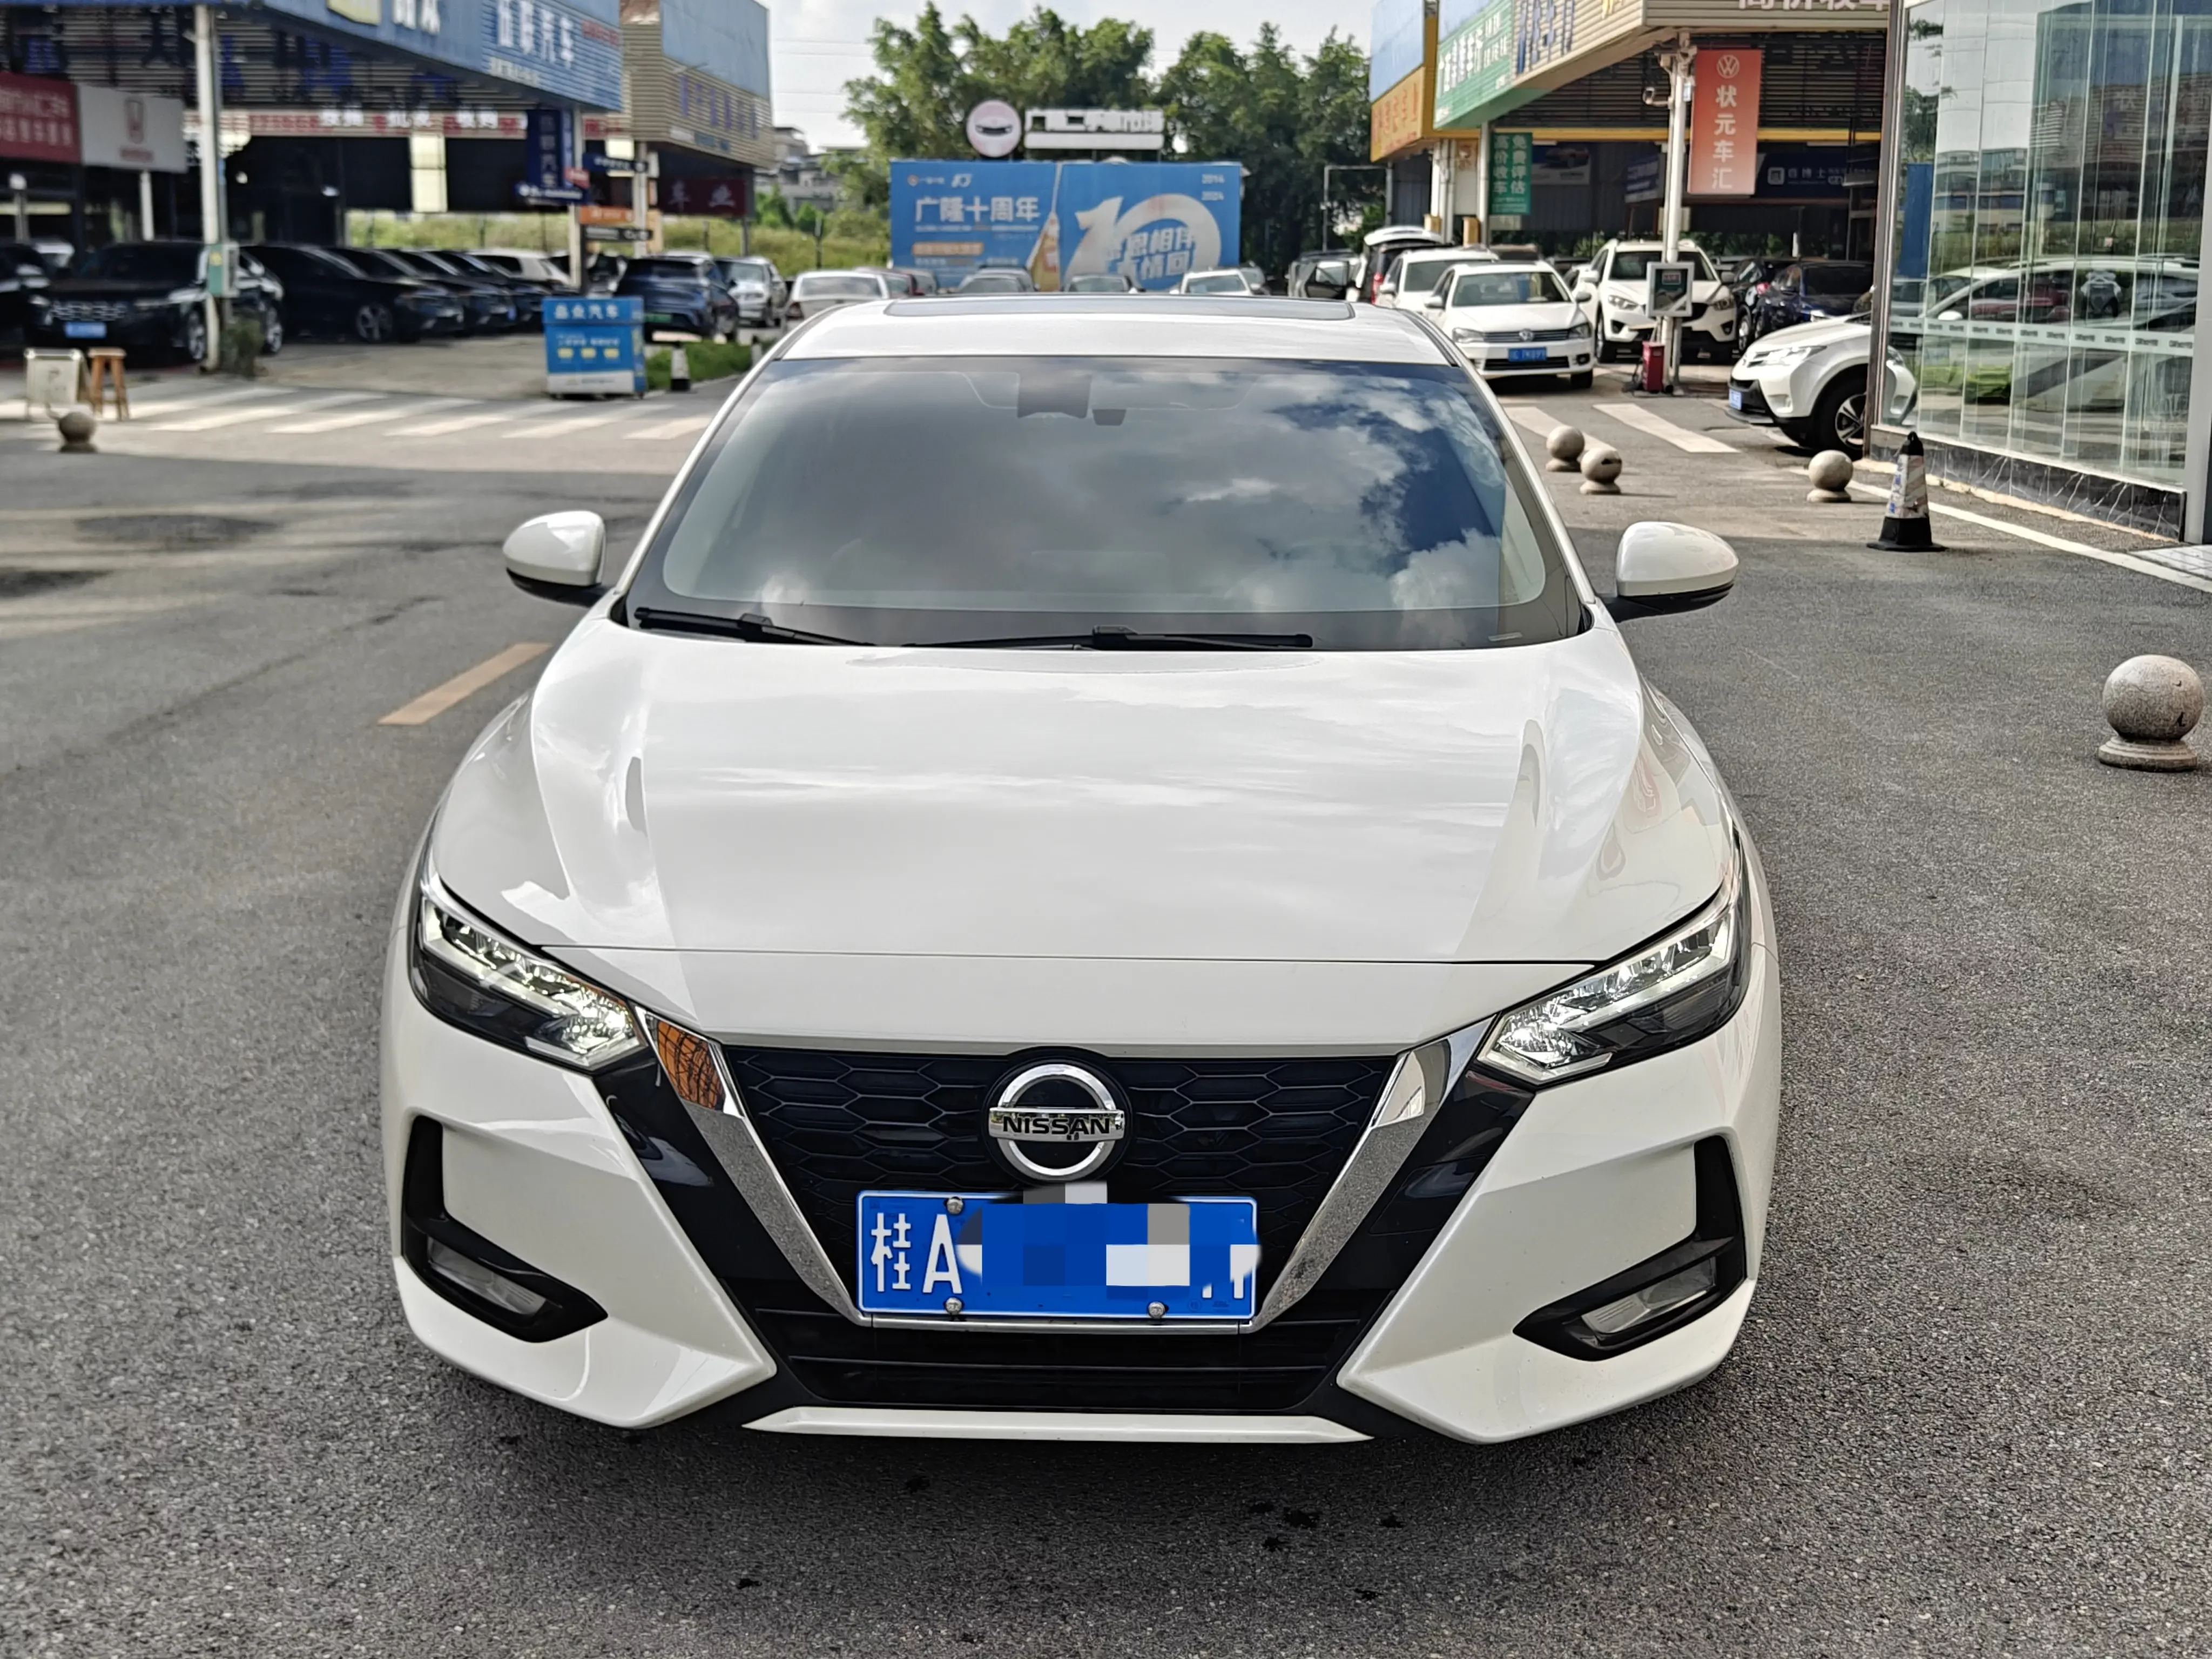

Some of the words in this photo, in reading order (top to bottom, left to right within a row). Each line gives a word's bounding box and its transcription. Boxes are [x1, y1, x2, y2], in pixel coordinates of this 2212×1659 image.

[1712, 85, 1737, 189] 状元车汇
[915, 195, 1041, 222] 广隆十周年
[1003, 1116, 1110, 1135] NISSAN
